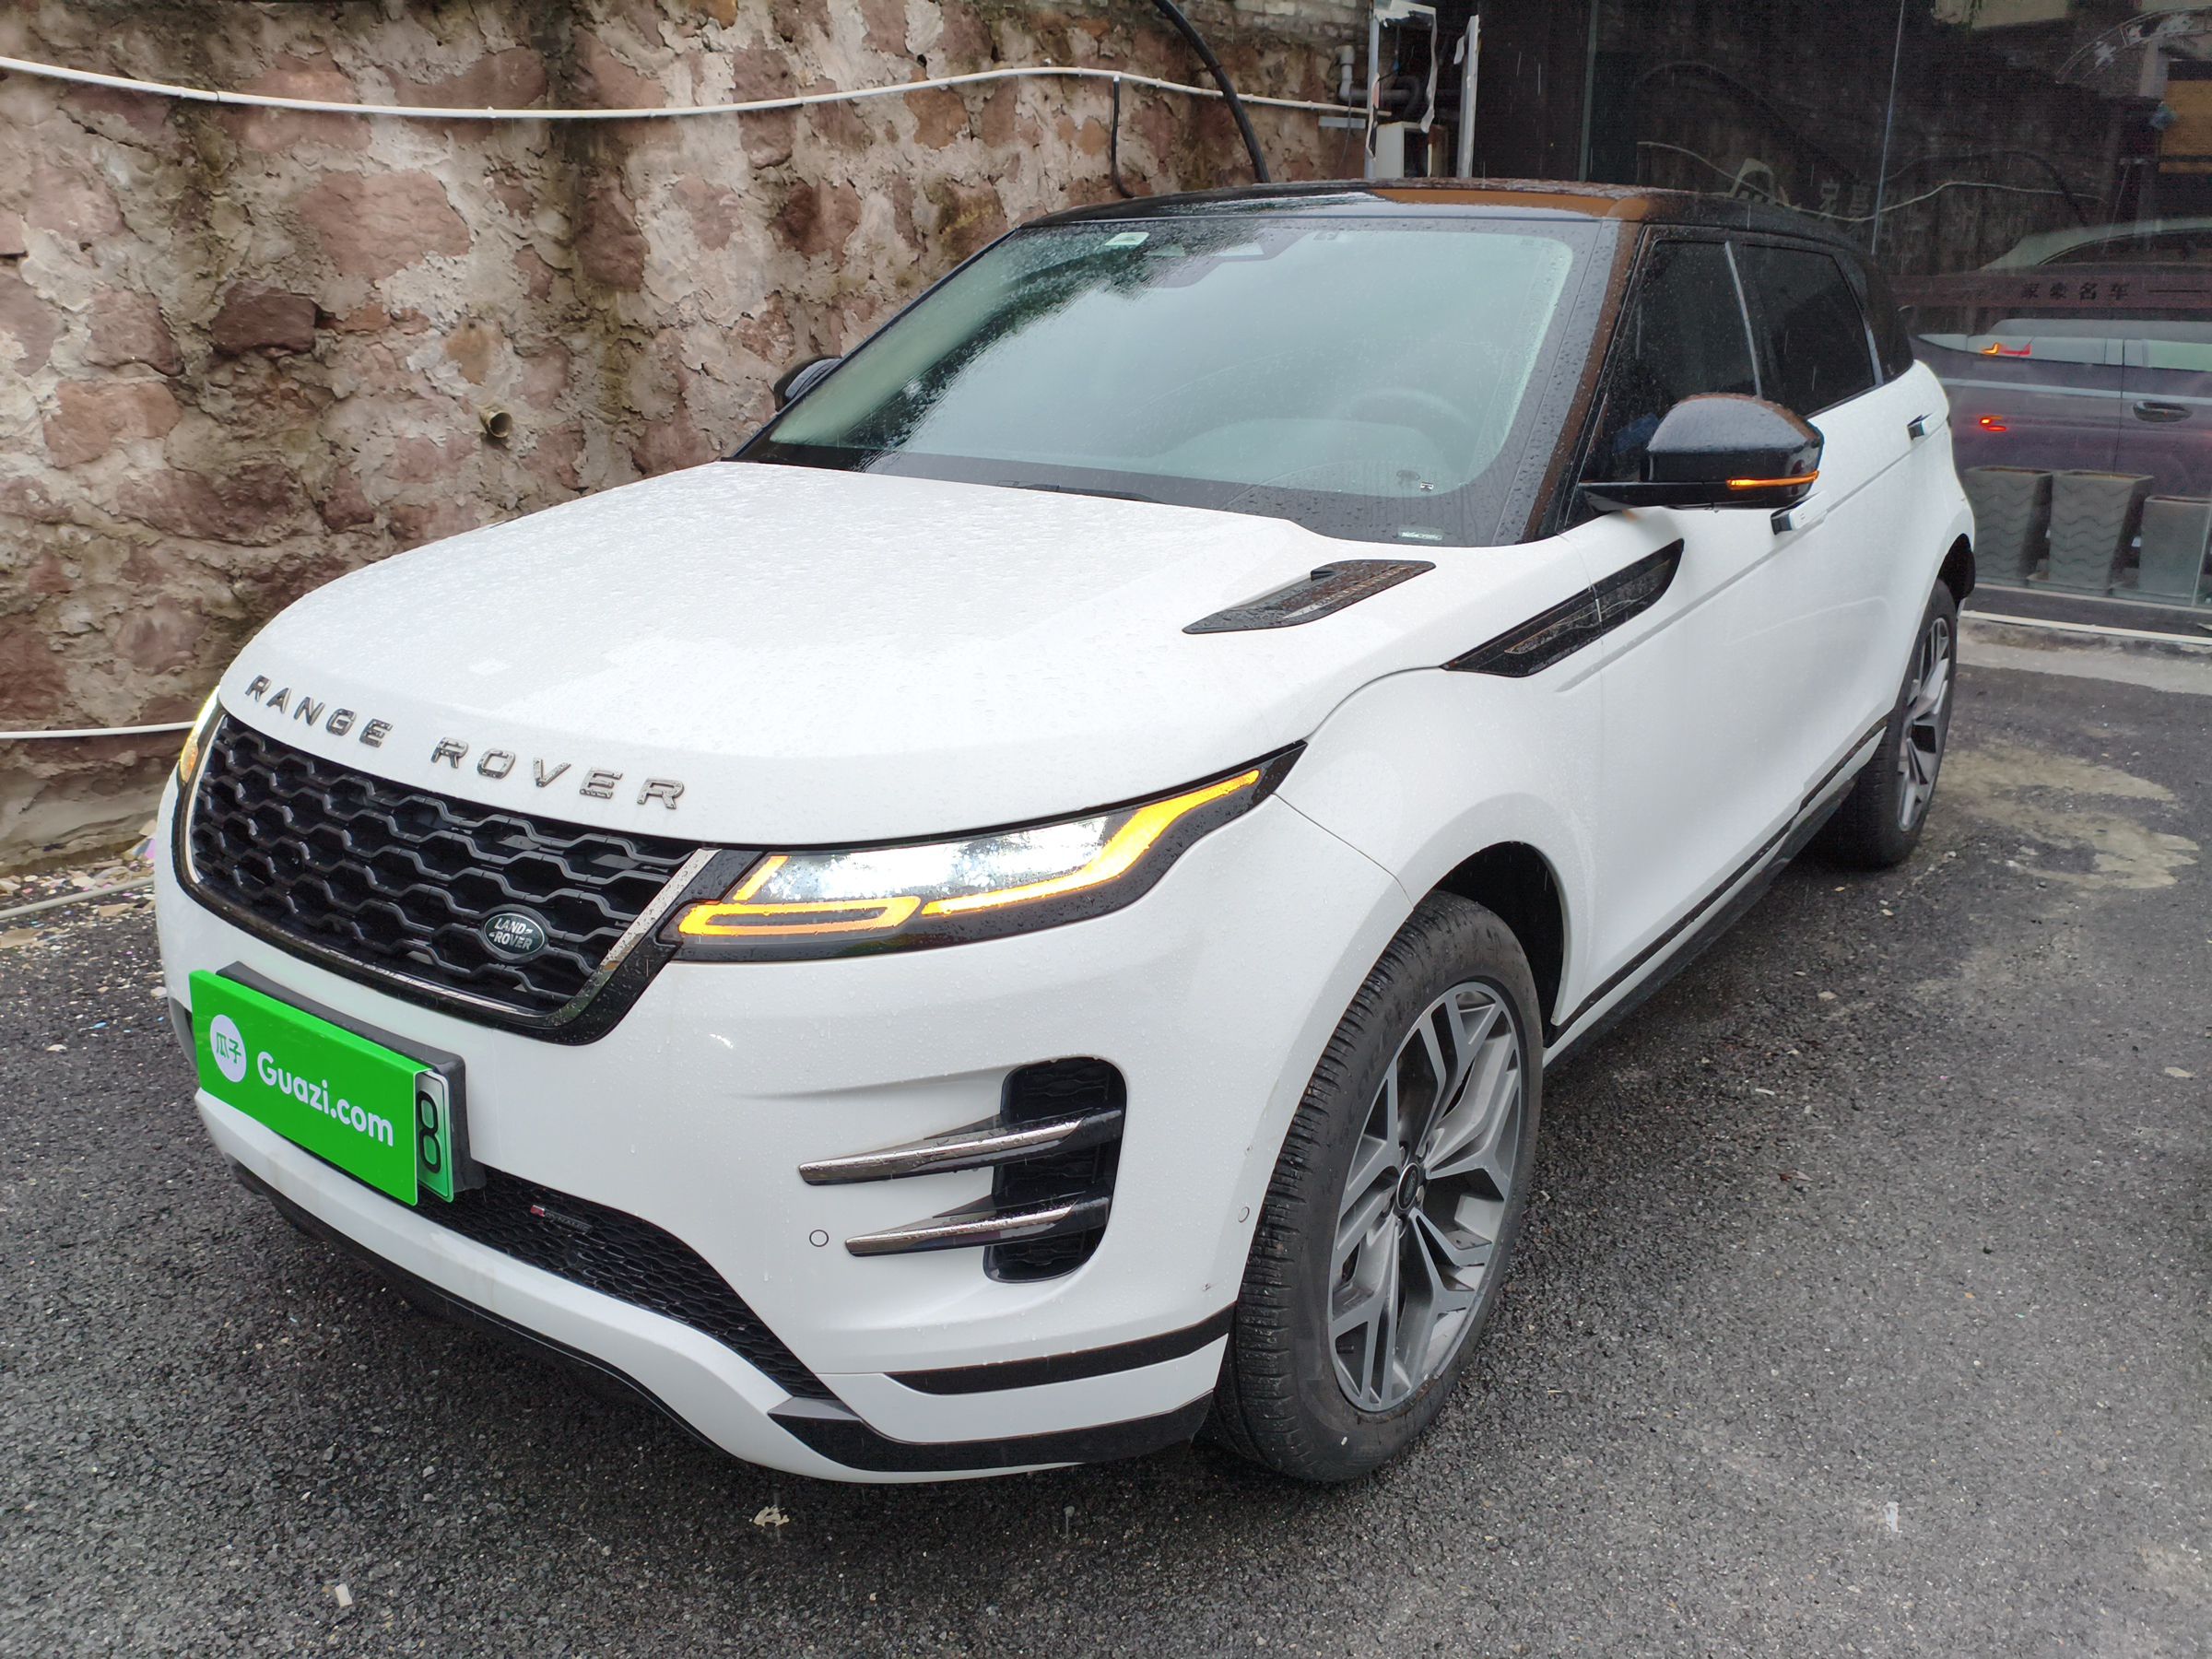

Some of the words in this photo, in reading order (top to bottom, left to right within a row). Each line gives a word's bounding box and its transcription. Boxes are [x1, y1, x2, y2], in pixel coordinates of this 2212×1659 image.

[244, 674, 393, 748] RANGE
[430, 736, 686, 810] ROVER
[494, 918, 527, 935] LAND
[494, 931, 533, 950] ROVER
[215, 1031, 241, 1065] 瓜子
[257, 1051, 394, 1147] Guazi.com
[417, 1090, 441, 1173] 8
